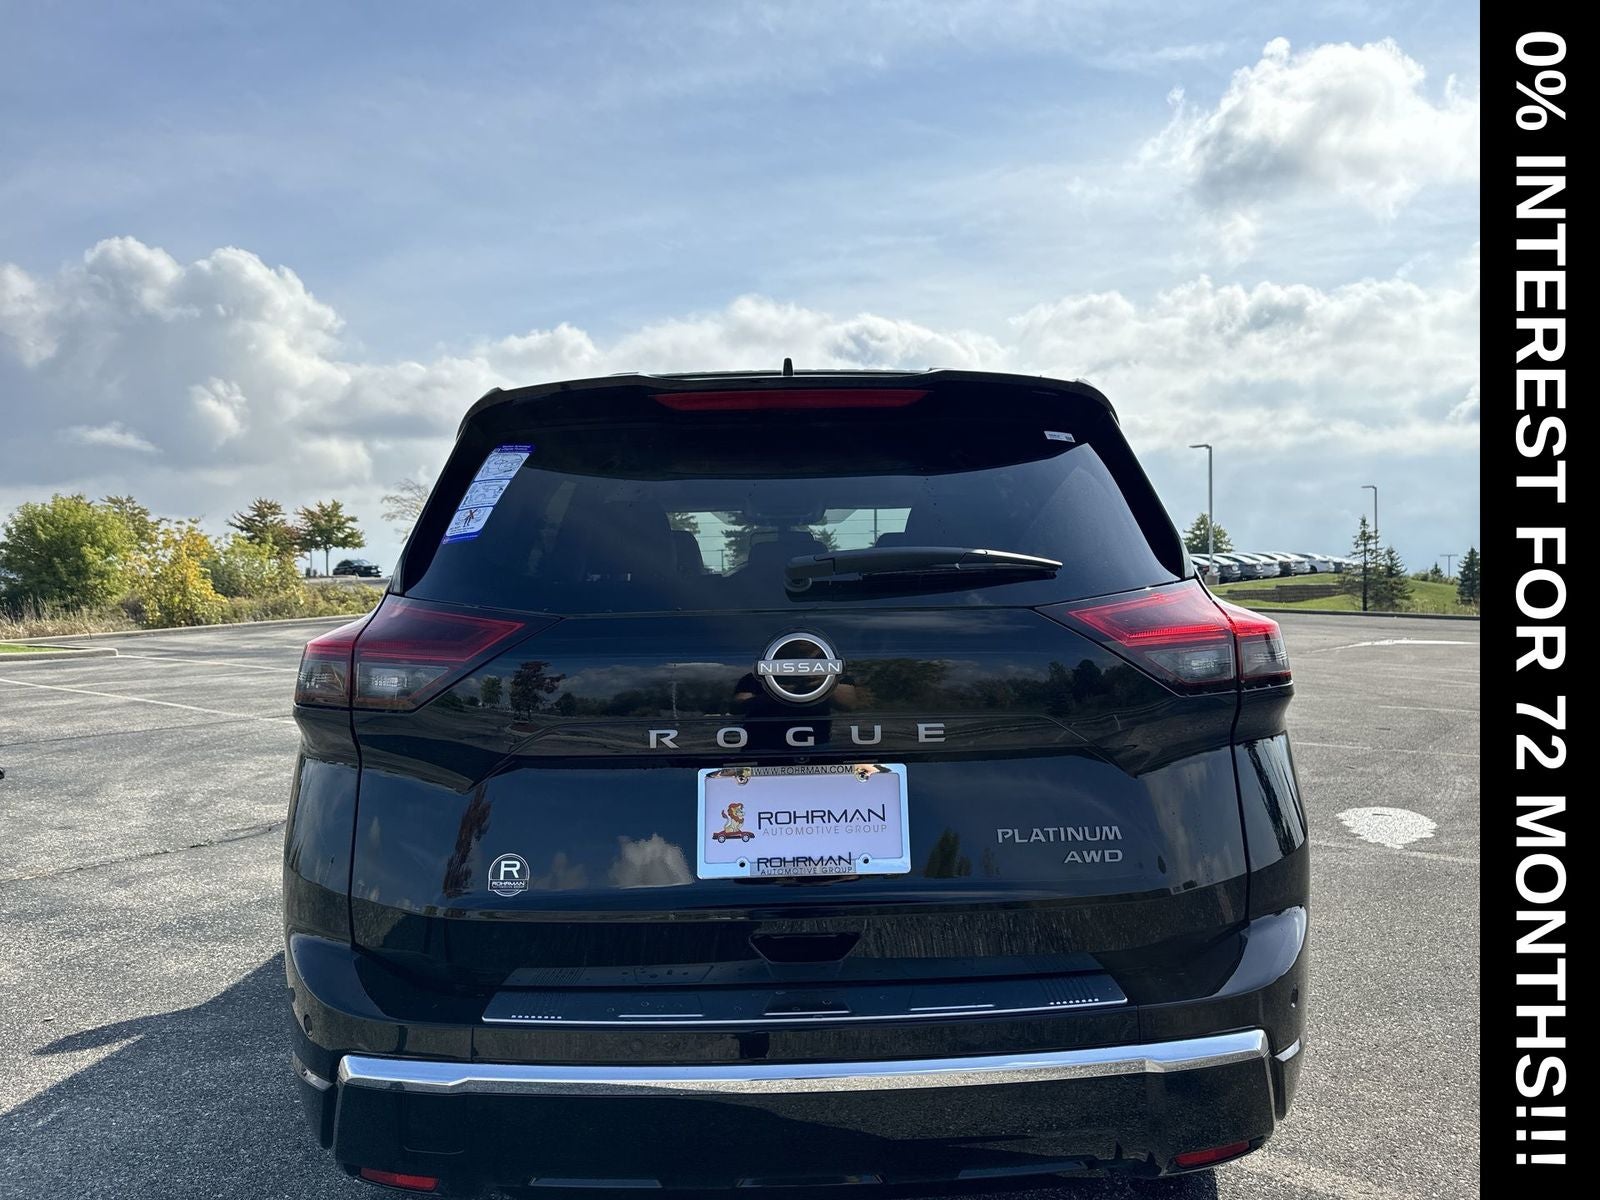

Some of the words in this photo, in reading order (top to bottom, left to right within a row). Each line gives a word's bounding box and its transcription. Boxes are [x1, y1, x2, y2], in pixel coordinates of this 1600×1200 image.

[760, 661, 841, 673] NISSAN
[648, 722, 947, 749] ROGUE
[752, 765, 853, 776] WWW.ROHRMAN.COM
[757, 803, 886, 830] ROHRMAN
[763, 826, 840, 836] AUTOMOTIVE
[845, 824, 887, 834] GROUP
[996, 825, 1123, 843] PLATINUM
[757, 852, 852, 872] ROHRMAN
[1063, 849, 1123, 863] AWD
[500, 860, 521, 880] R
[760, 867, 818, 876] AUTOMOTIVE
[822, 866, 853, 874] GROUP
